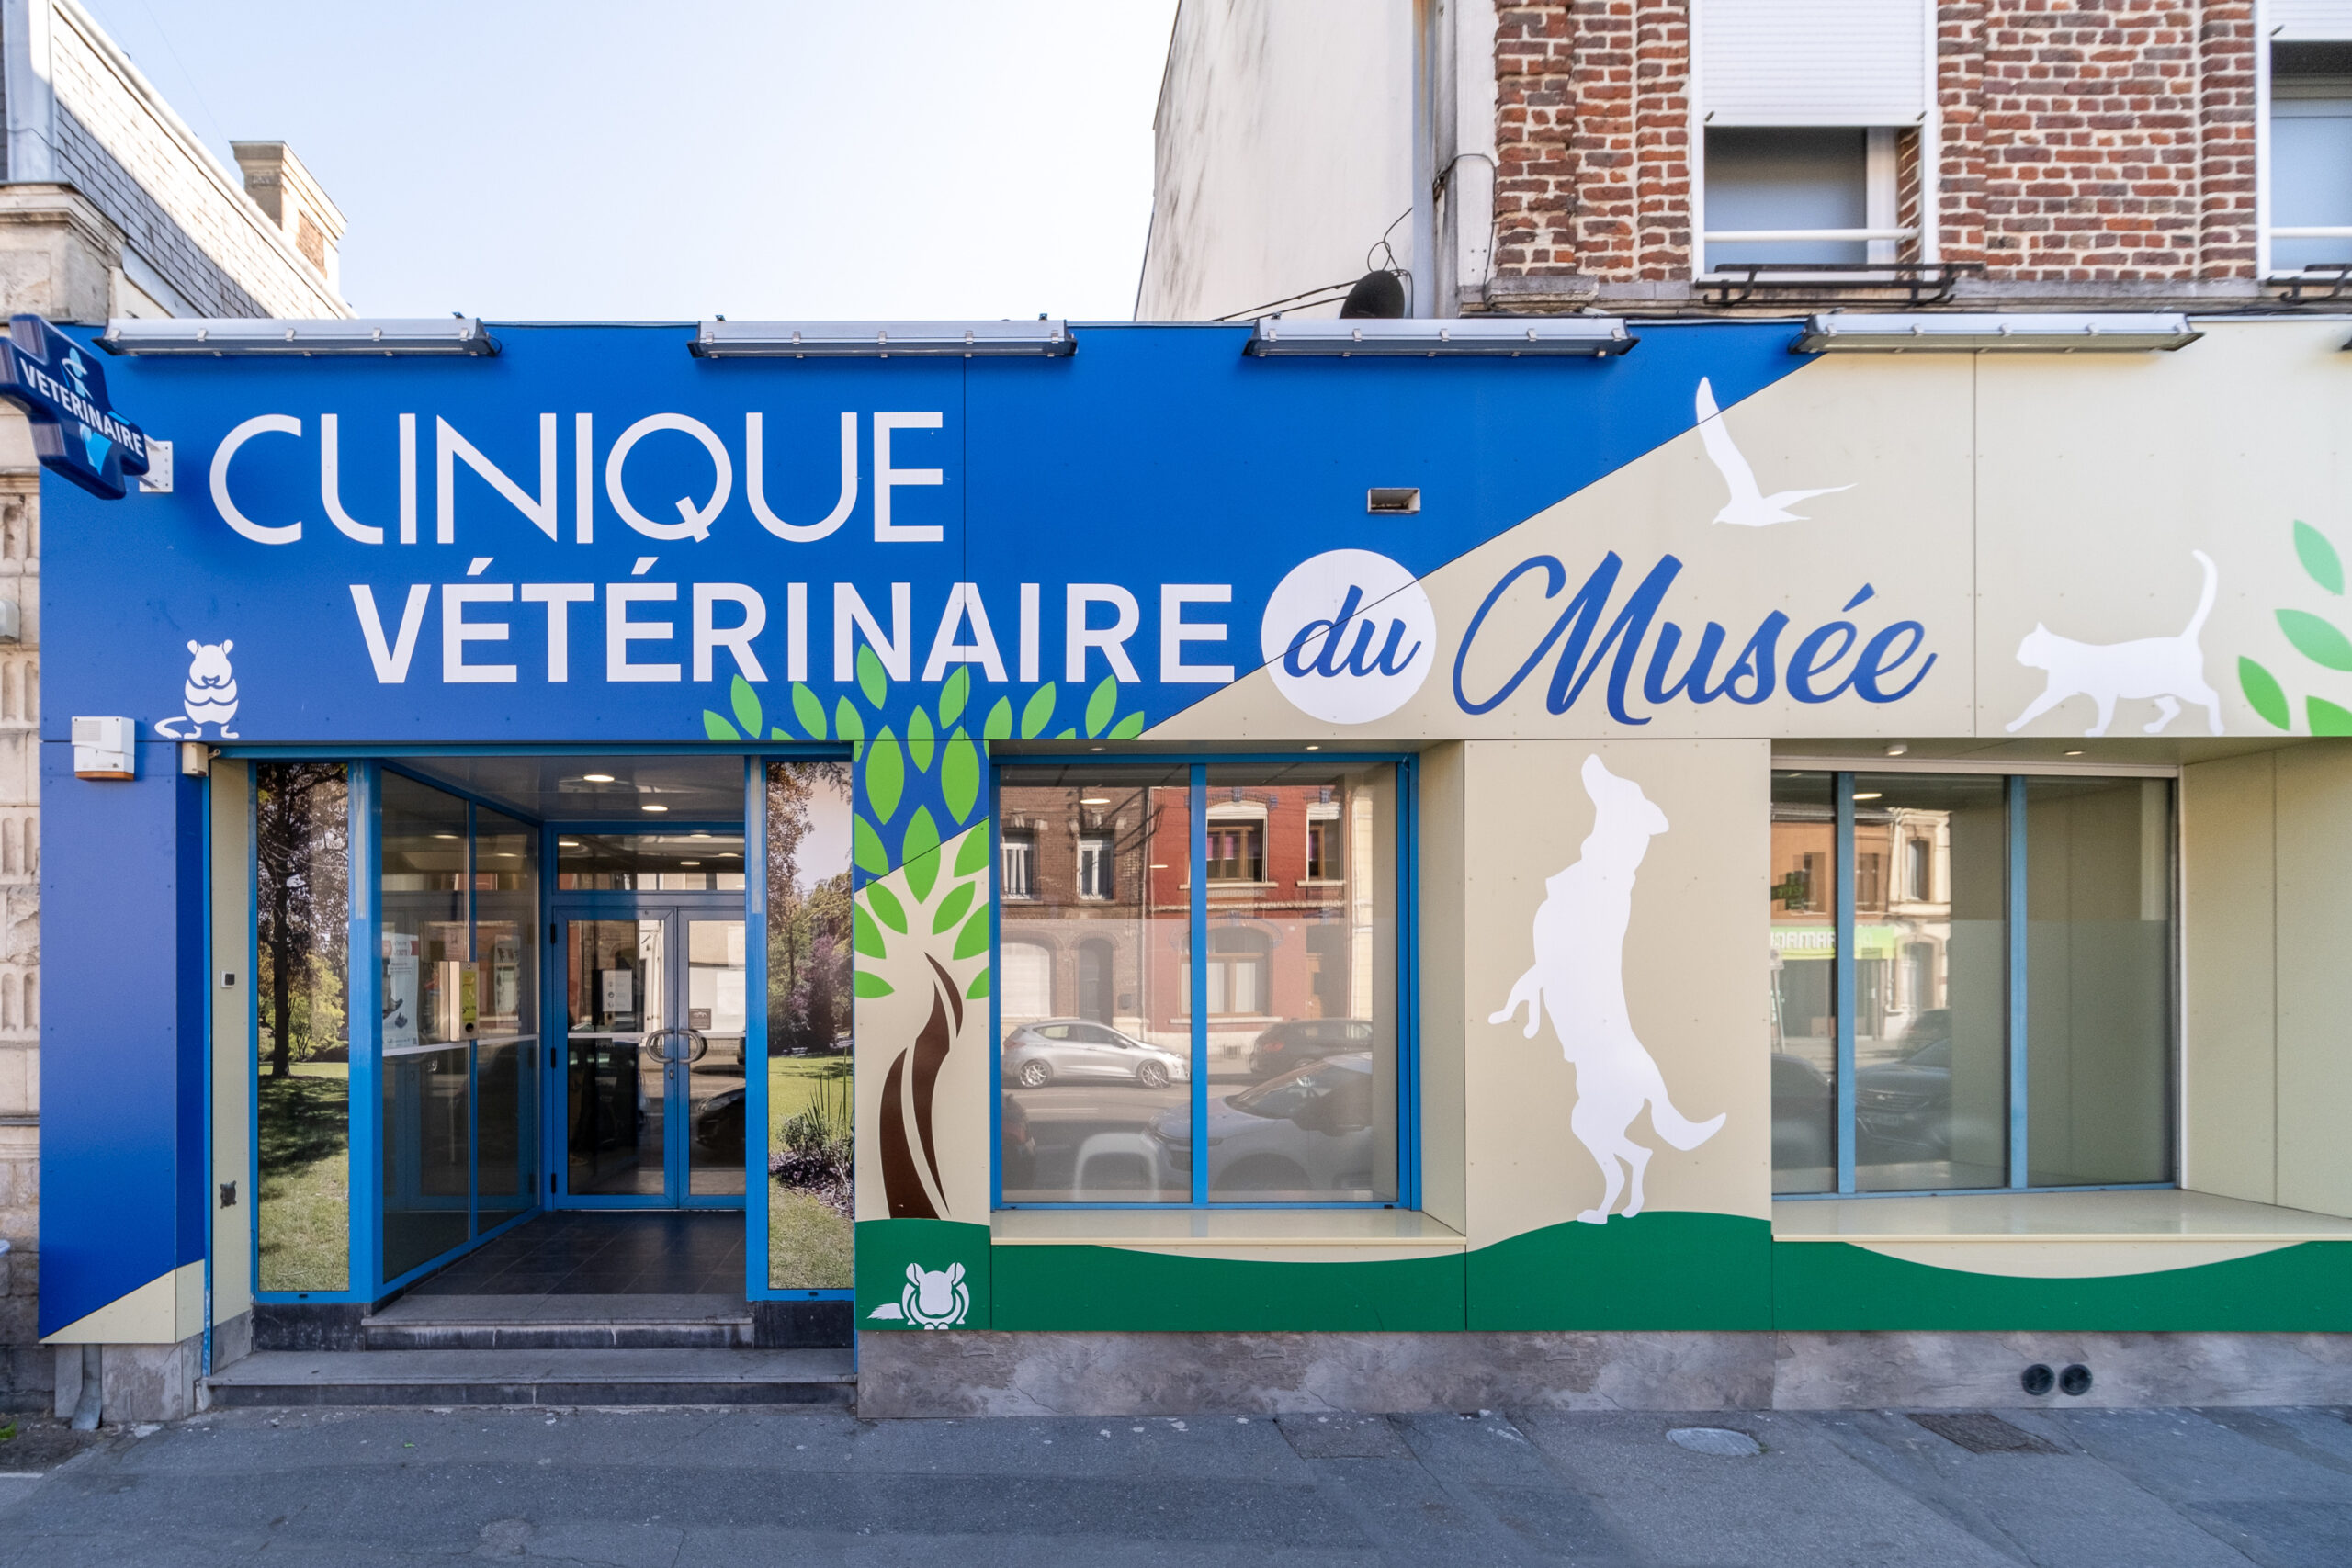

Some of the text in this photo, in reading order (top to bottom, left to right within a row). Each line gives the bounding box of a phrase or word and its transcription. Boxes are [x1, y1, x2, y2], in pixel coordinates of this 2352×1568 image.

[19, 356, 145, 458] VETERINAIRE
[209, 412, 944, 545] CLINIQUE
[349, 550, 1939, 726] VÉTÉRINAIRE du Musée
